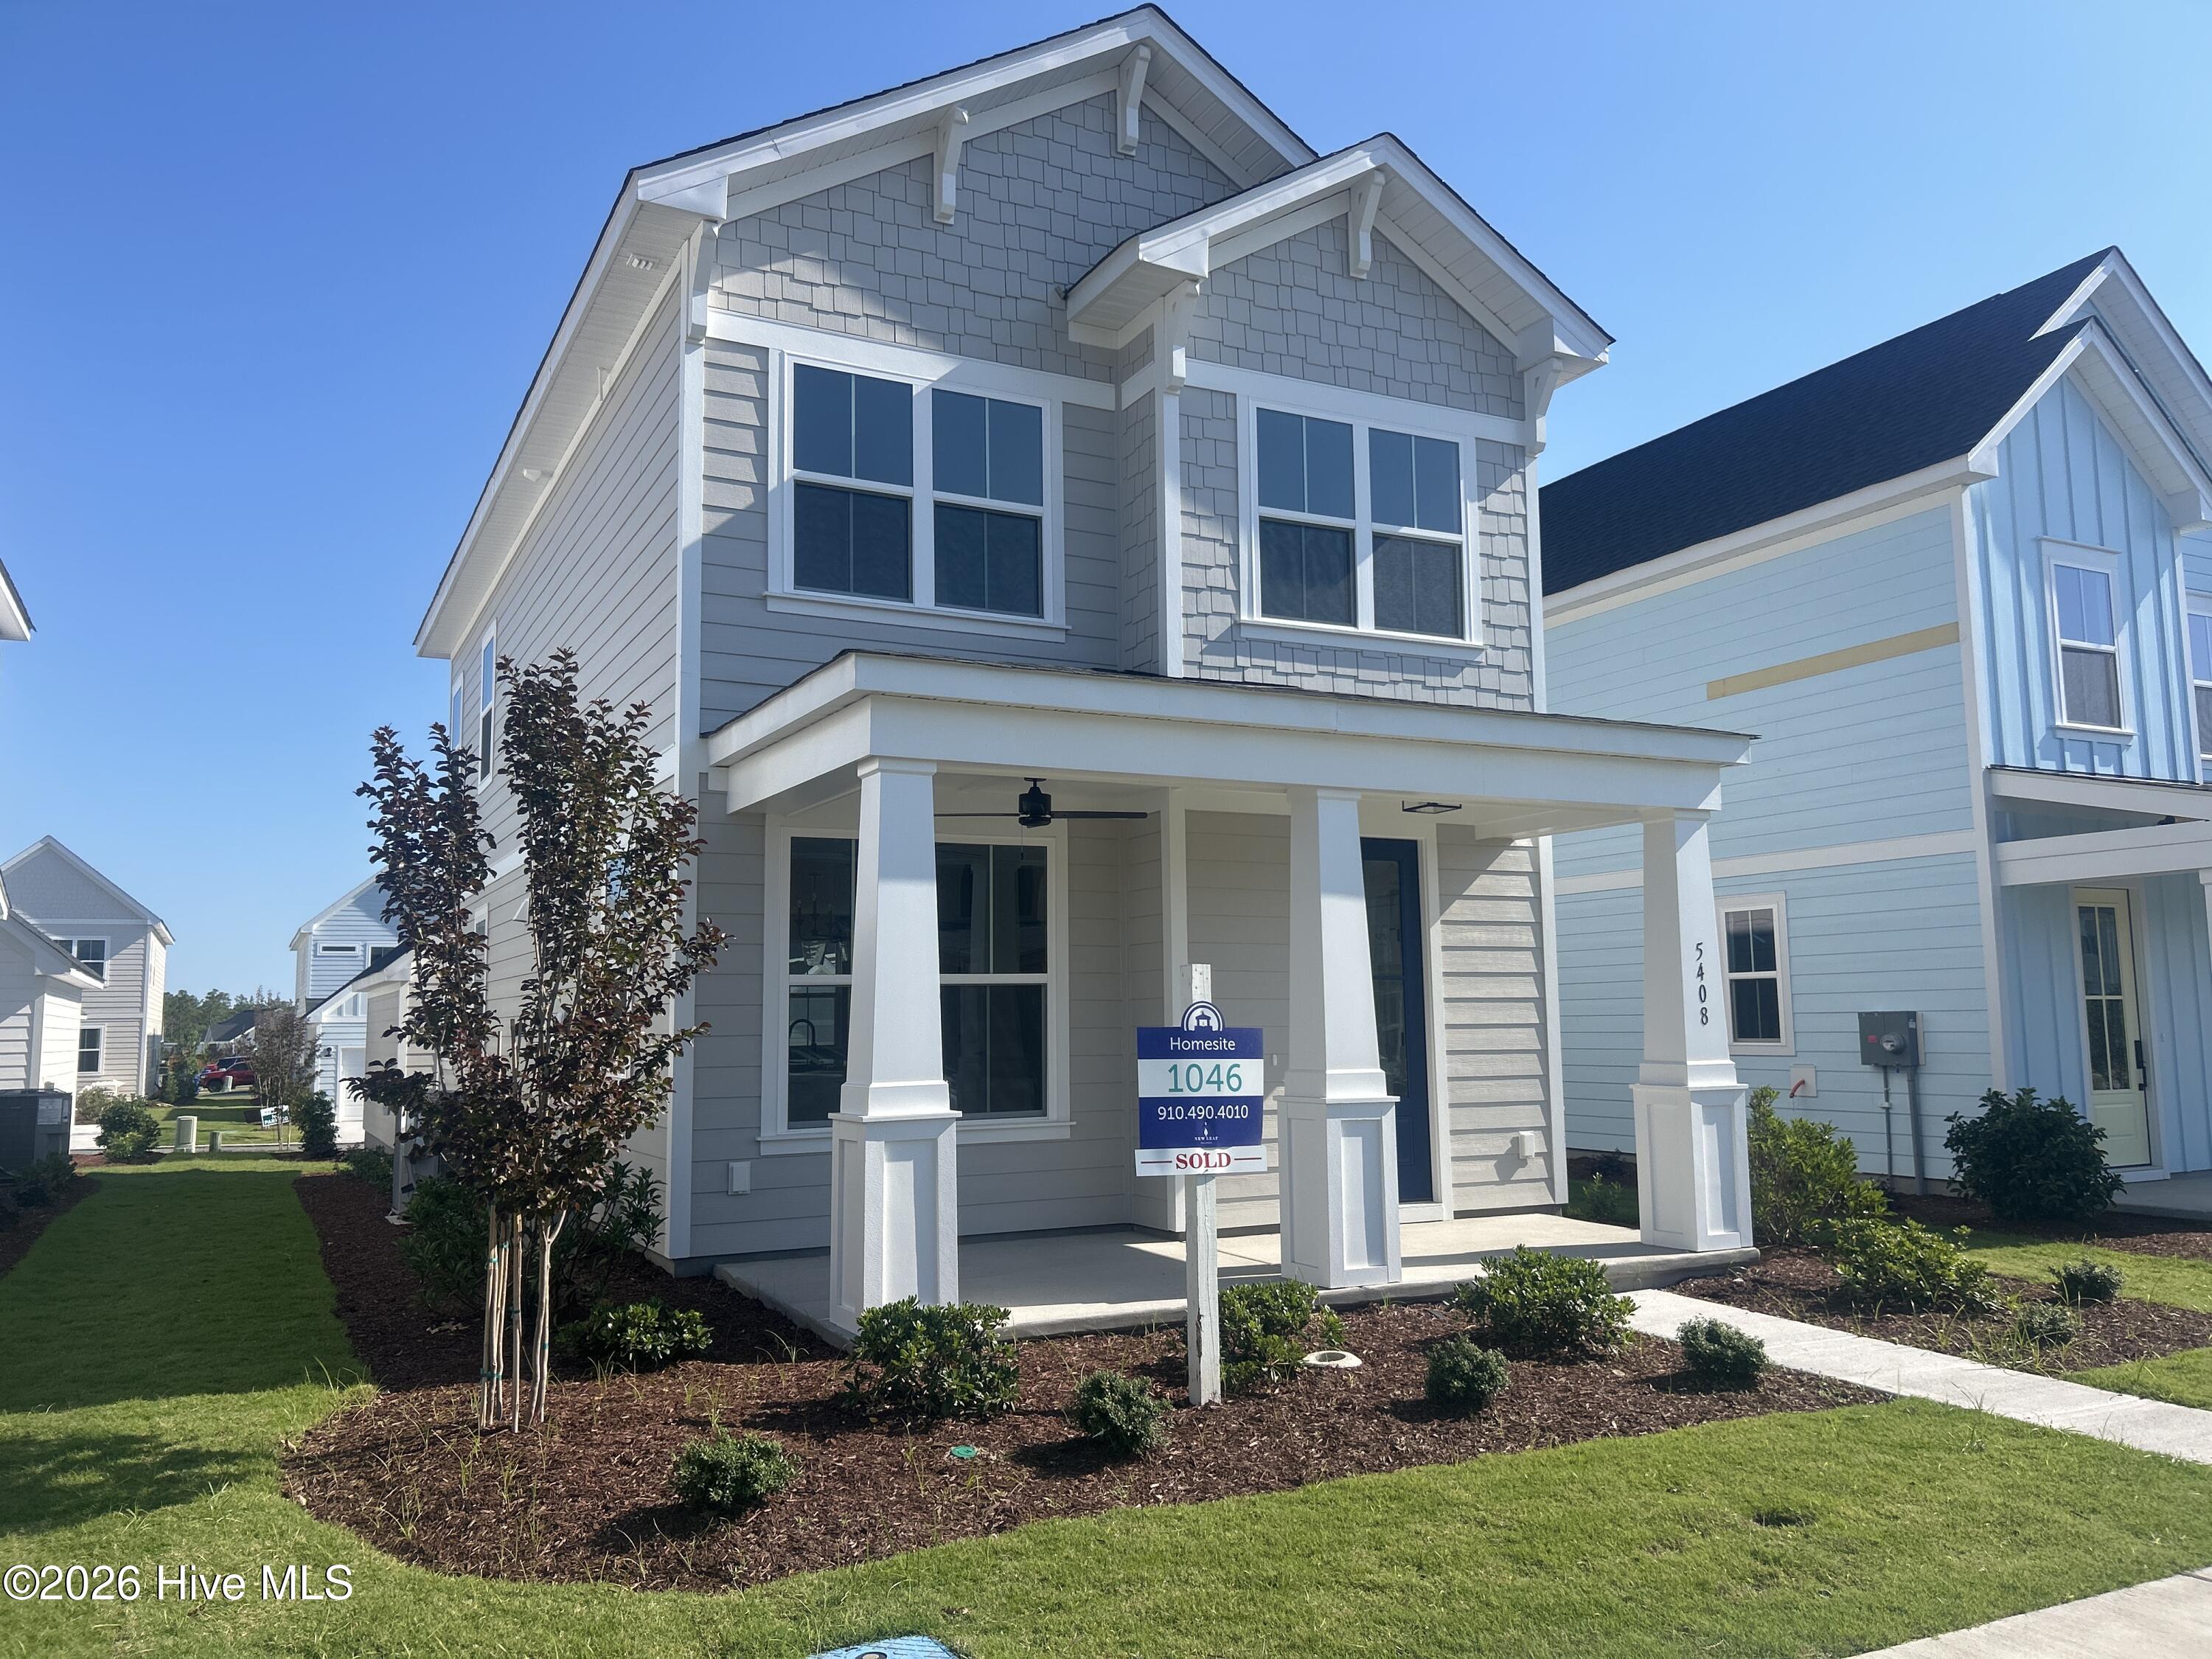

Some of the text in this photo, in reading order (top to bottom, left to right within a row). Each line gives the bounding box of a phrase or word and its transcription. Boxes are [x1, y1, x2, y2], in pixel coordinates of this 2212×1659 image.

[1695, 942, 1708, 1026] 5408
[1169, 1037, 1236, 1051] Homesite
[1168, 1063, 1242, 1093] 1046
[1158, 1105, 1248, 1121] 910.490.4010
[1175, 1152, 1231, 1169] SOLD
